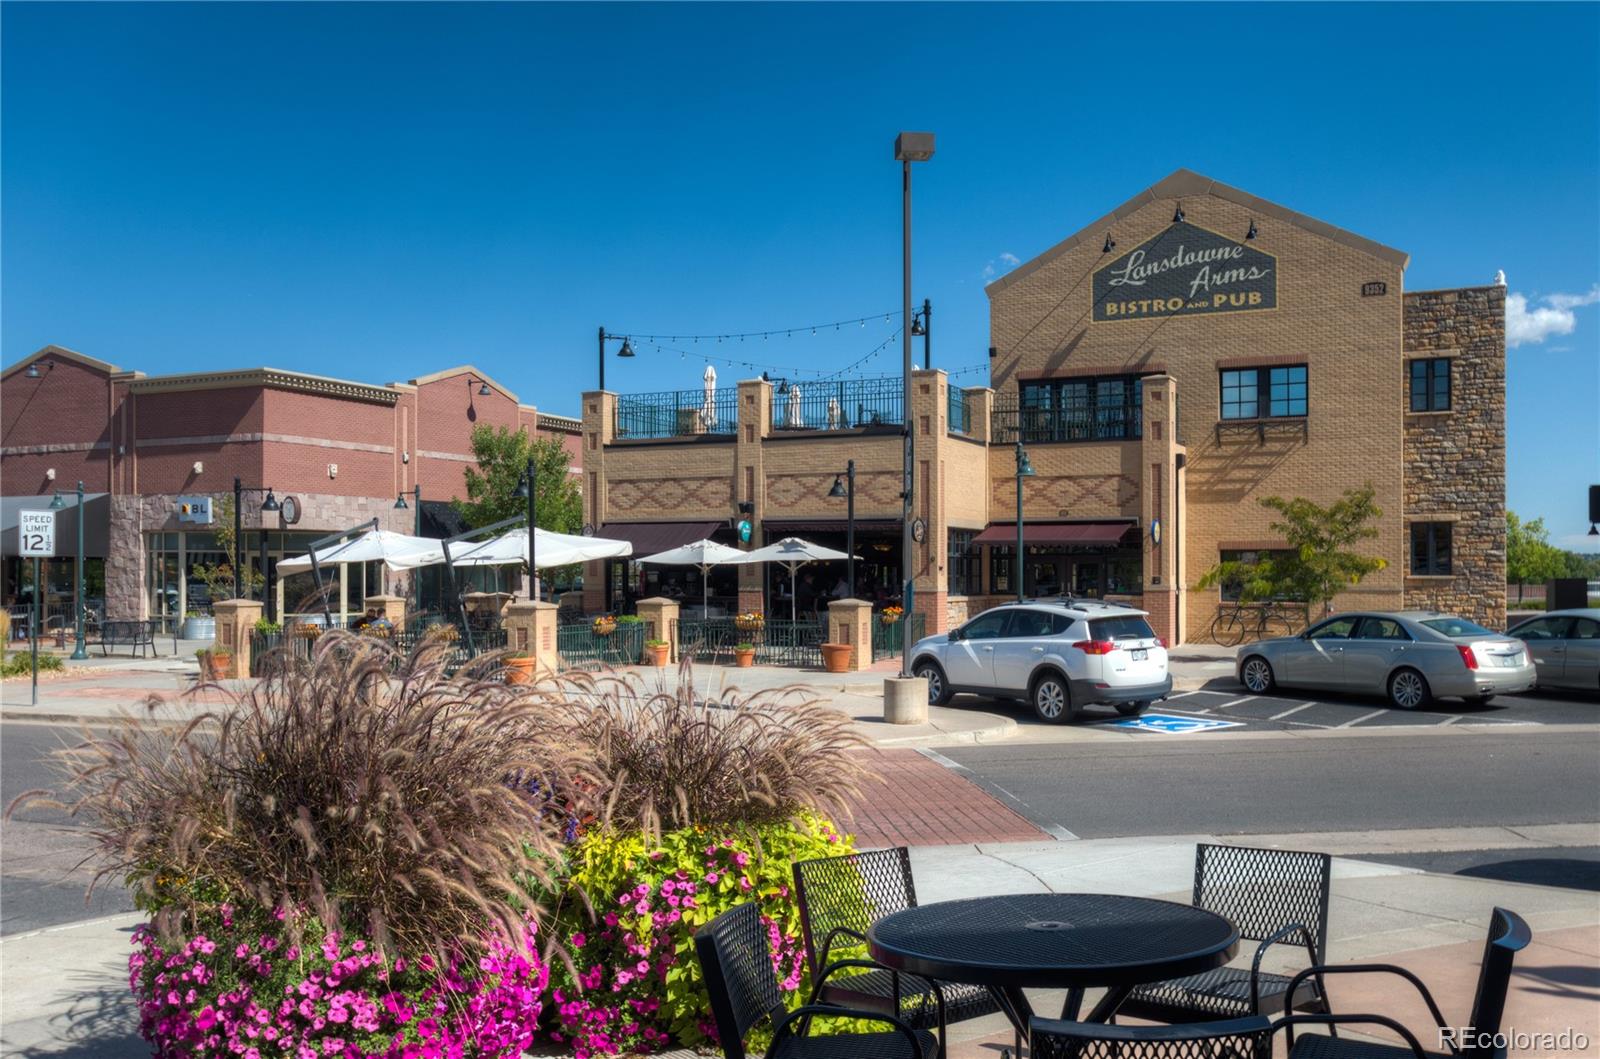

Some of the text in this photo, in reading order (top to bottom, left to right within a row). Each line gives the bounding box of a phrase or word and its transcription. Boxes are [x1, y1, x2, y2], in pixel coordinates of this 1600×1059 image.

[1109, 245, 1244, 286] Lansdowne
[1189, 265, 1272, 298] Arms
[1105, 291, 1263, 316] BISTRO AND PUB
[23, 515, 52, 524] SPEED
[25, 525, 48, 533] LIMIT
